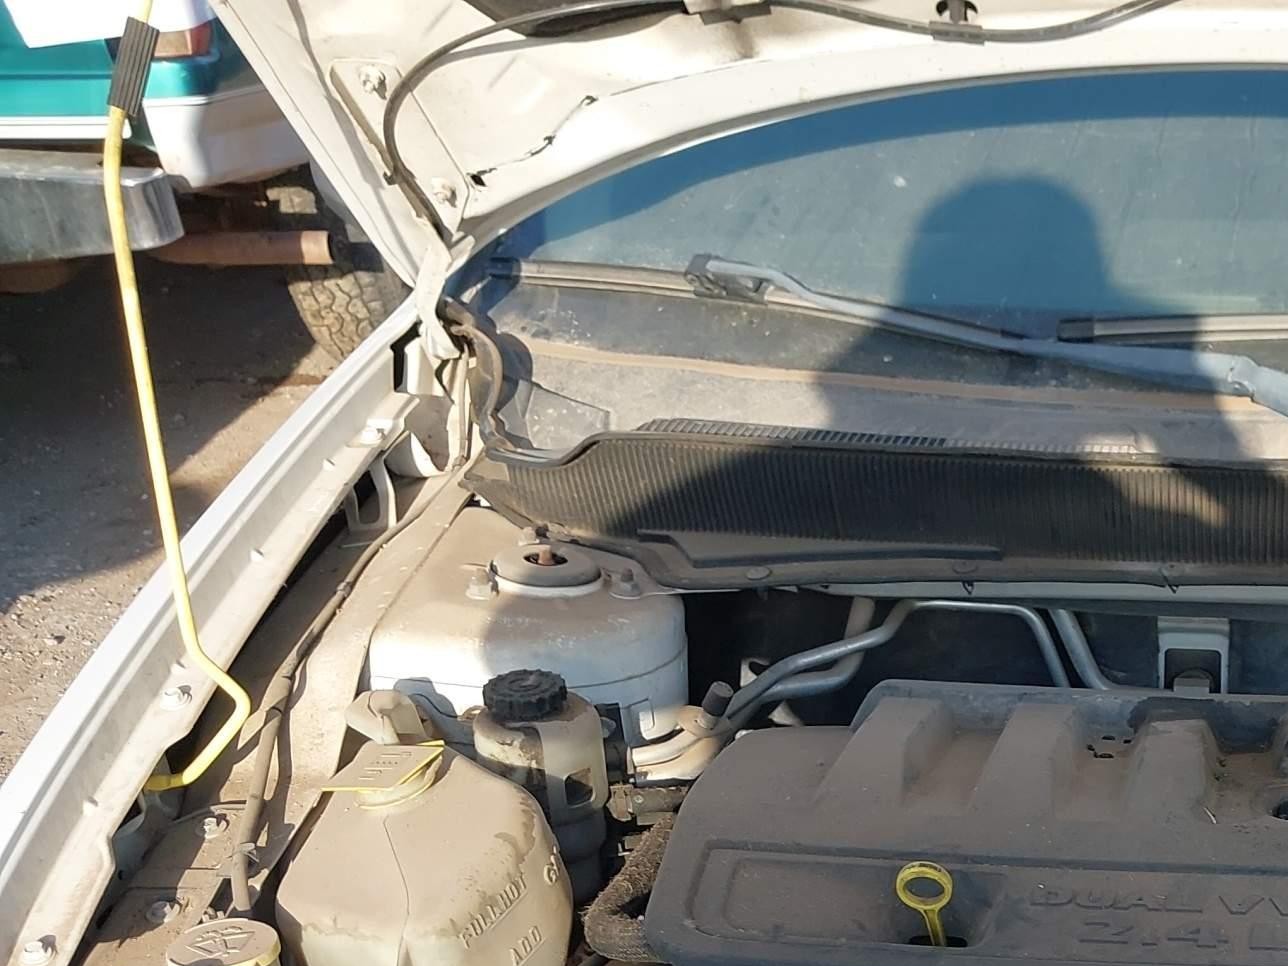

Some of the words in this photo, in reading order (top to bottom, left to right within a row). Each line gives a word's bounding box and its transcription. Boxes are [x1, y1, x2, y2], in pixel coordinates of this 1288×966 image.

[456, 903, 503, 950] FULL
[497, 871, 528, 910] HOT
[1029, 888, 1204, 914] DUAL
